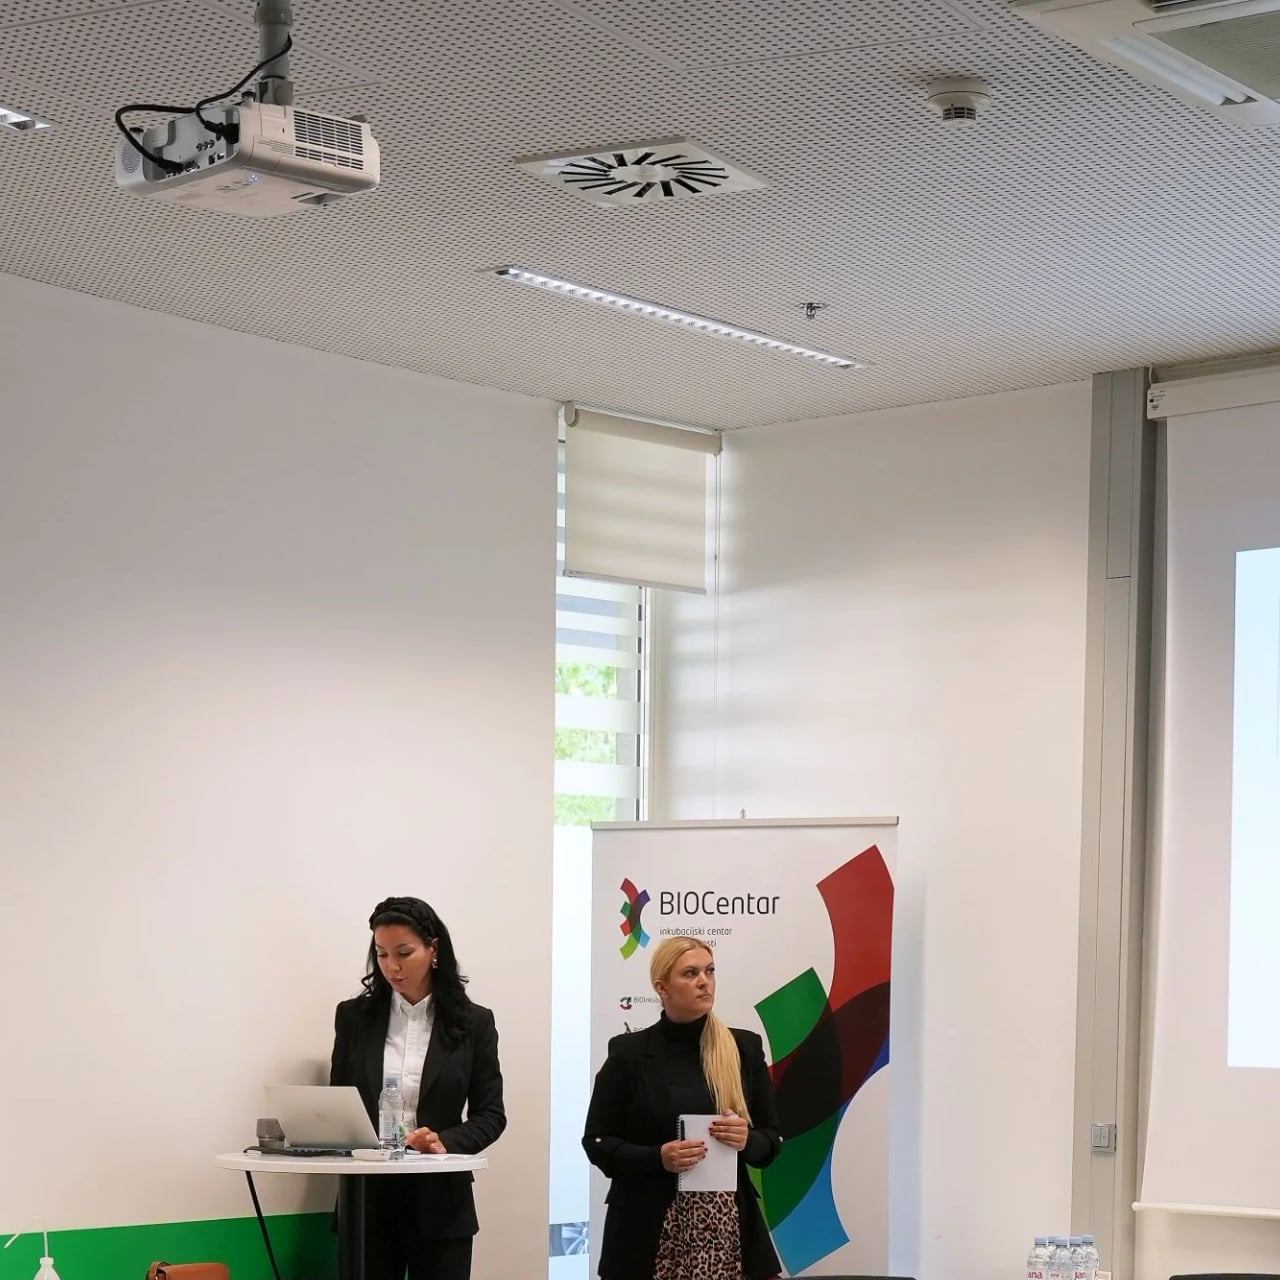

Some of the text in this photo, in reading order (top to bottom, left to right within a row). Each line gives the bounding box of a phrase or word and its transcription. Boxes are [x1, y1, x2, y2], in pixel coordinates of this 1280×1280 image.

[659, 891, 780, 916] BIOCentar
[659, 926, 733, 938] inkubacijski centar
[1028, 1271, 1043, 1280] ana
